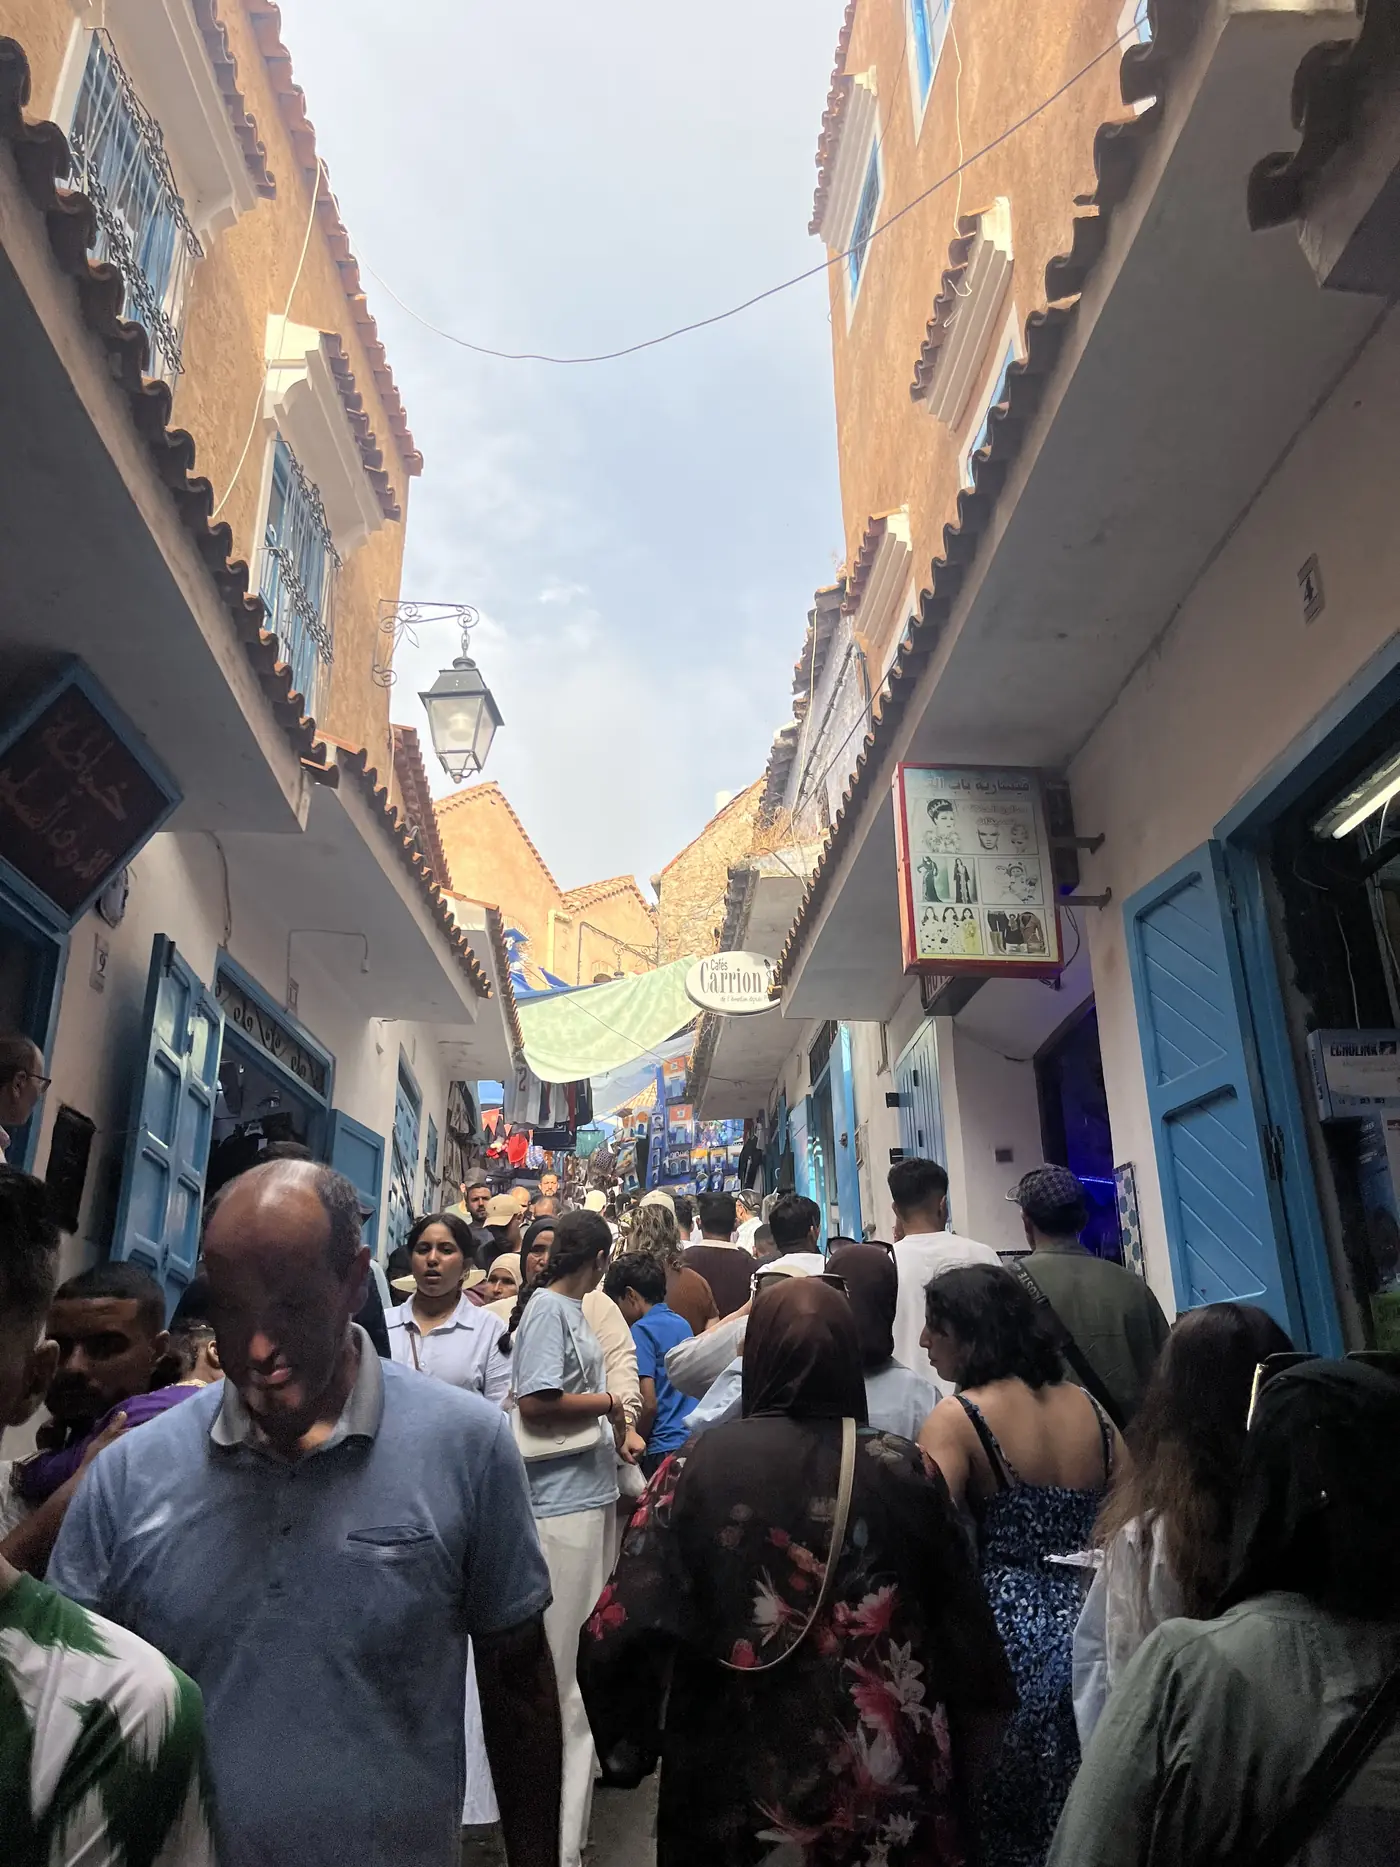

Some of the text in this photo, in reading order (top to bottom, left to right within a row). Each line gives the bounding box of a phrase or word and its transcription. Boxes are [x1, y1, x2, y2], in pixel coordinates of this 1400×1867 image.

[949, 778, 970, 795] باب
[710, 958, 728, 971] Cafés
[700, 962, 762, 993] Carrion
